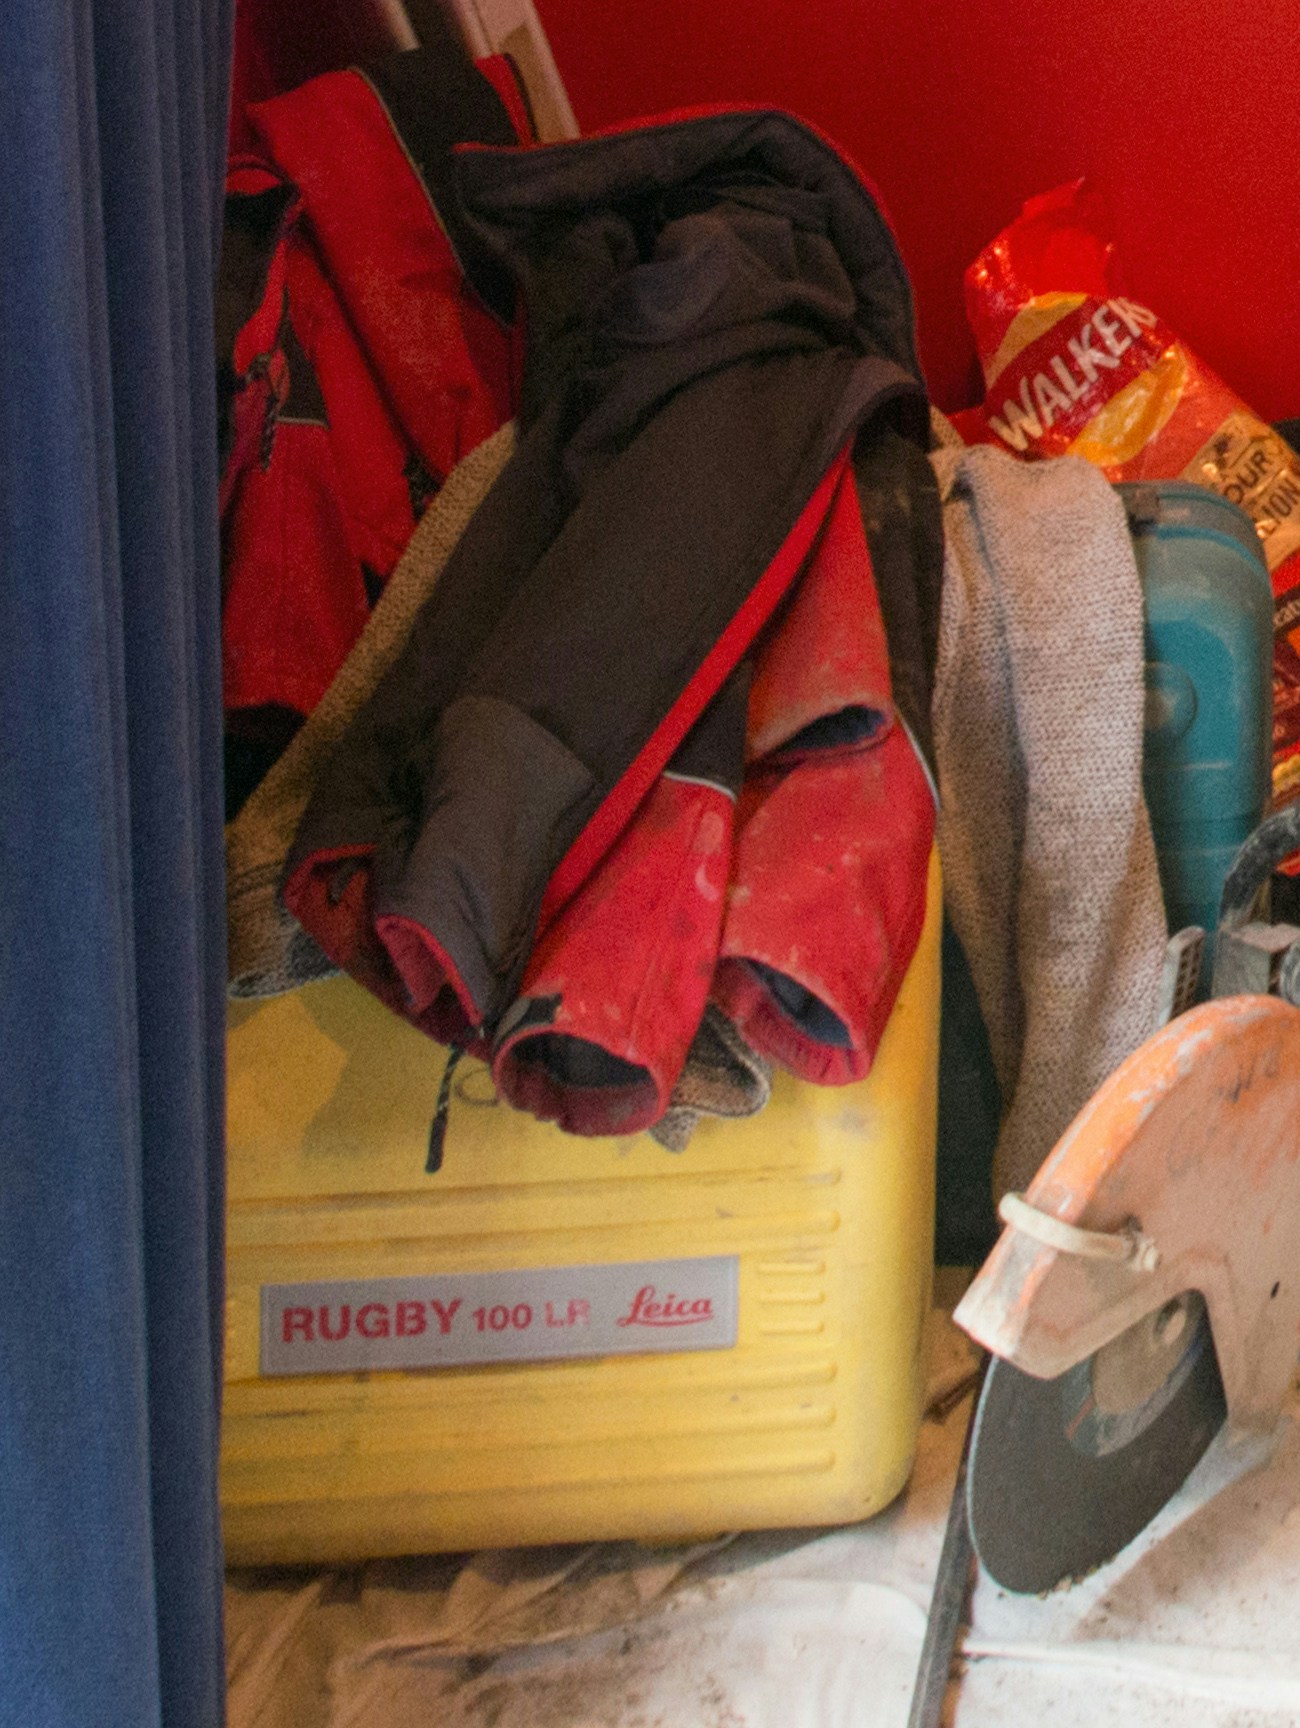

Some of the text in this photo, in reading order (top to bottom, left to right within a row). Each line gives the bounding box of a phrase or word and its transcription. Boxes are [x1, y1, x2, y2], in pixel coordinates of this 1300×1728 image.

[281, 1284, 715, 1344] RUGBY 100 LR Leica
